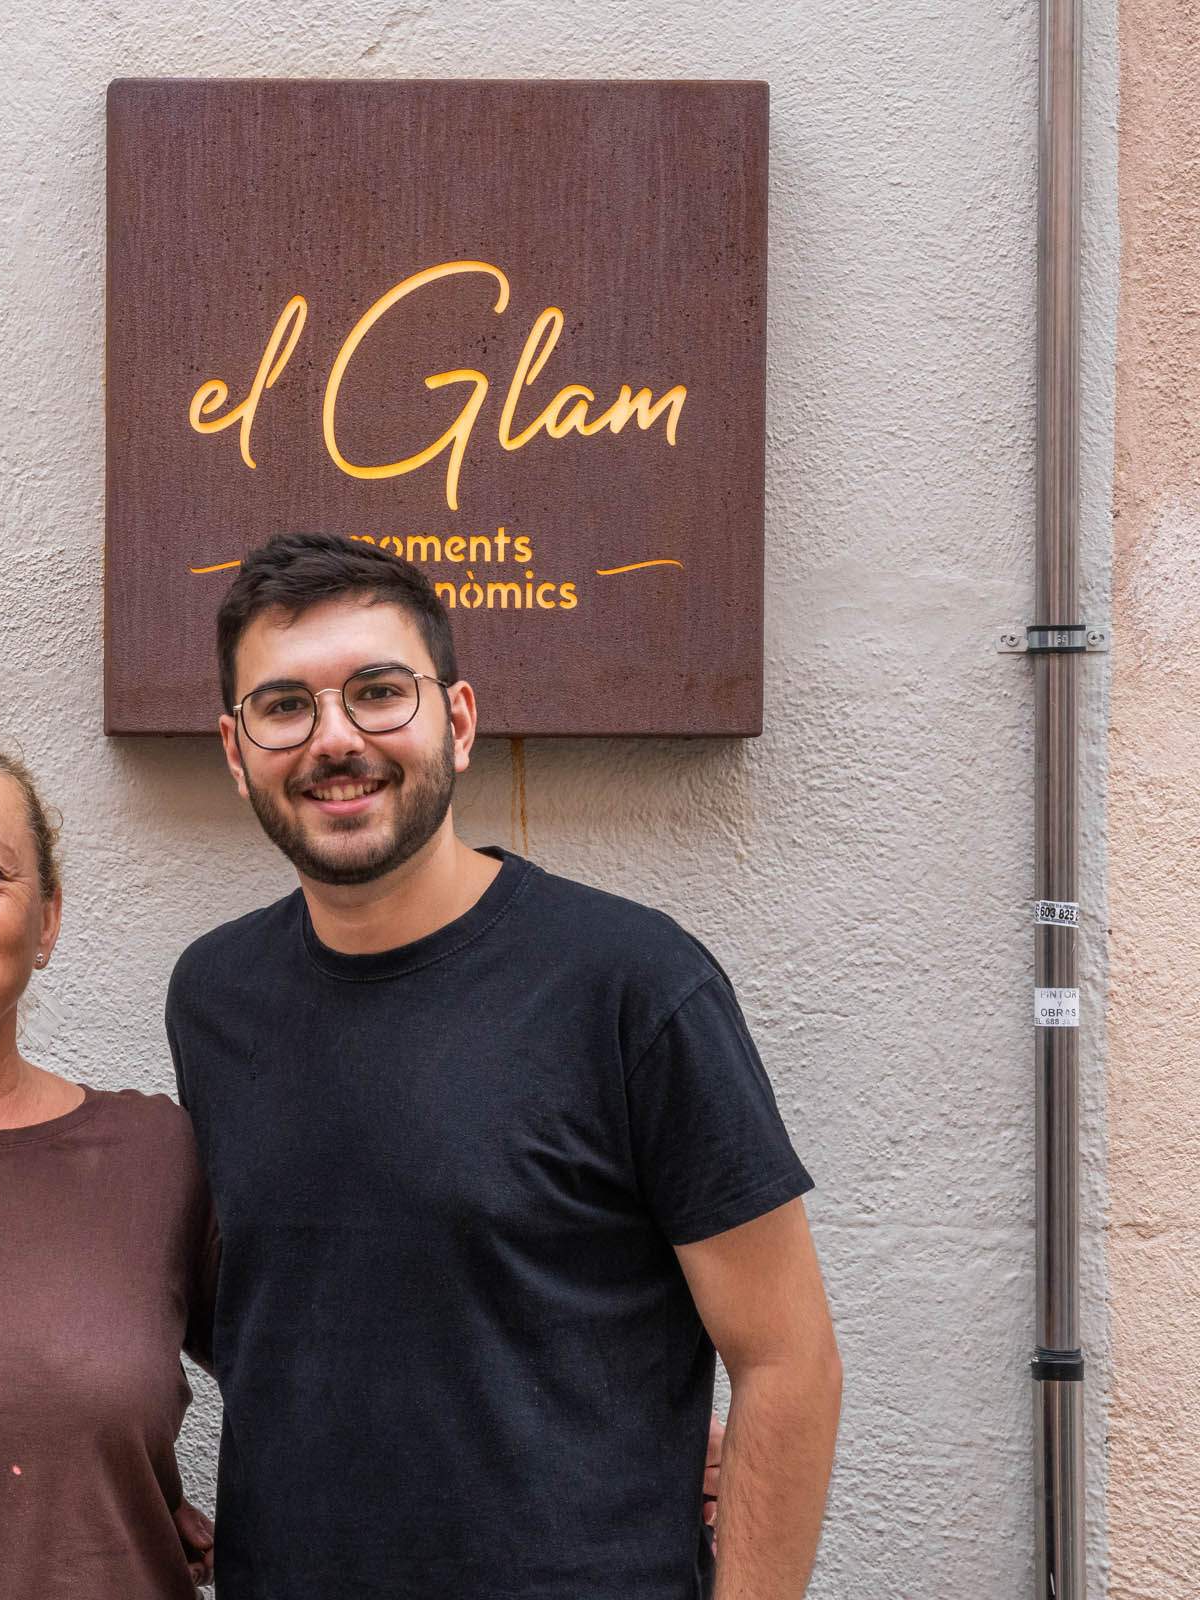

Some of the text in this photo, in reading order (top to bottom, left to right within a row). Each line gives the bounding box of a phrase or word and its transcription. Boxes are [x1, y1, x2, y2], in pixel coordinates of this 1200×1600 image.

[189, 260, 688, 511] el Glam
[434, 570, 578, 610] nòmics
